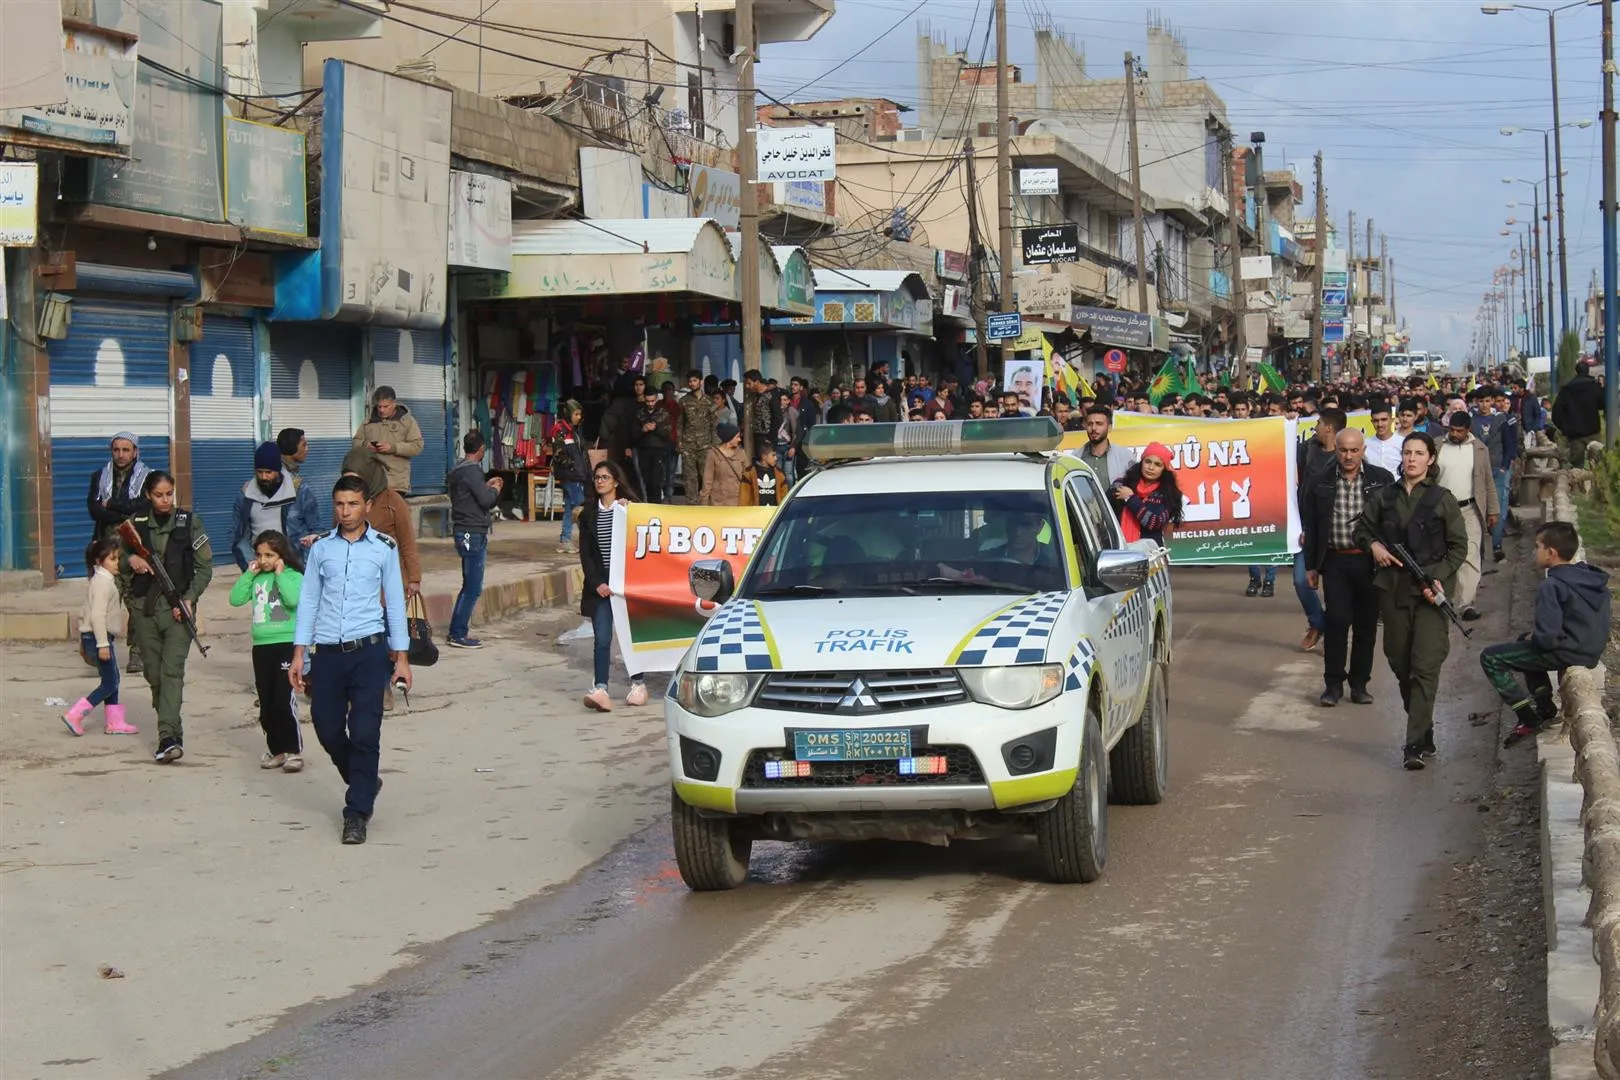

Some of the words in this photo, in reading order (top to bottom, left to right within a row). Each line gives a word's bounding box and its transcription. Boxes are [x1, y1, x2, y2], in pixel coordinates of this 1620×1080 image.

[761, 148, 781, 165] حاجي
[782, 147, 799, 162] خليل
[767, 169, 825, 179] AVOCAT
[1038, 229, 1062, 242] المحامي
[1025, 243, 1046, 258] عثمان
[1046, 242, 1077, 257] سليمان
[1051, 256, 1076, 264] AVOCAT
[1207, 439, 1250, 468] NA
[634, 516, 662, 560] JÎ
[668, 526, 716, 555] BO
[1172, 527, 1216, 539] MECLISA
[1217, 526, 1249, 537] GIRGÊ
[1250, 523, 1277, 534] LEGÊ
[862, 732, 908, 744] 200226
